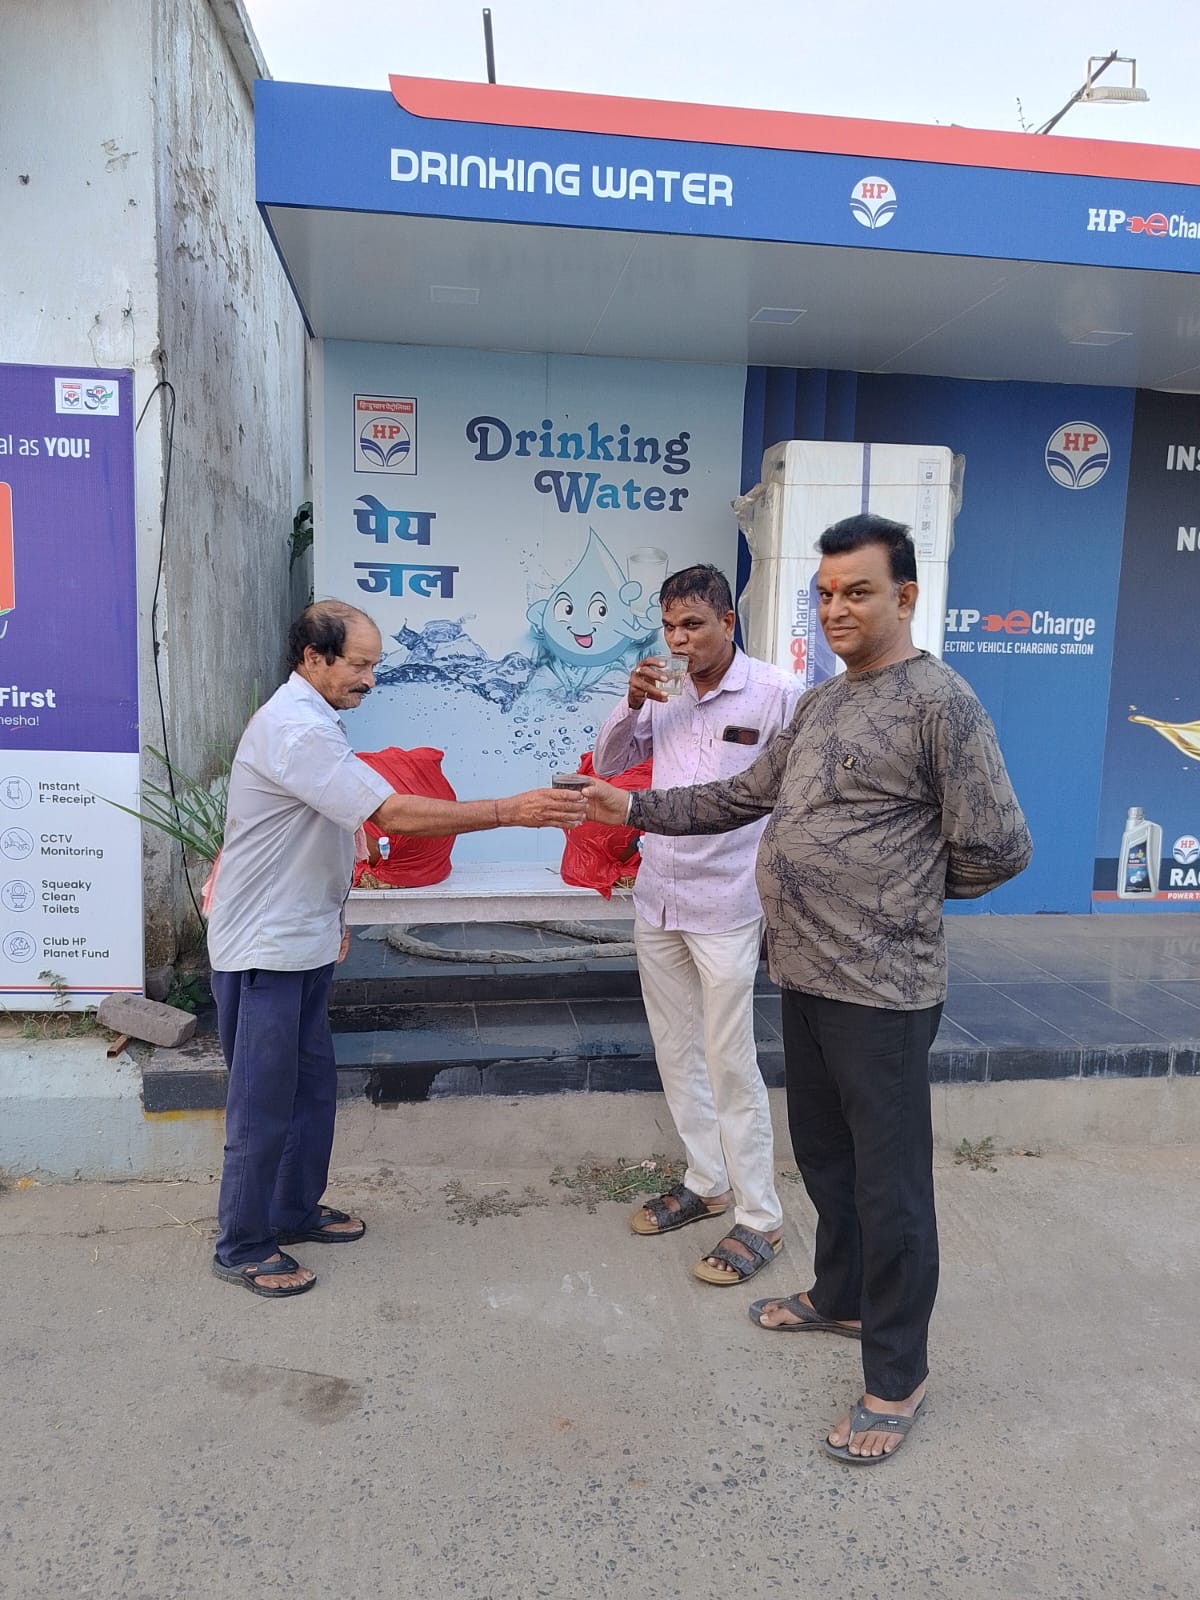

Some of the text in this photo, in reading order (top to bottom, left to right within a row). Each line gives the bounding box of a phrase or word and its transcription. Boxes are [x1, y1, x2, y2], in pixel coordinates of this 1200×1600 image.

[391, 148, 733, 207] DRINKING WATER
[861, 183, 889, 200] HP
[1087, 208, 1126, 232] HP
[372, 424, 401, 440] HP
[19, 439, 39, 456] as
[44, 437, 90, 459] YOU!
[466, 416, 691, 475] Drinking
[1063, 433, 1098, 452] HP
[534, 470, 689, 514] Water
[353, 494, 437, 546] पेय
[1177, 526, 1200, 551] N
[354, 561, 460, 599] जल
[977, 642, 1013, 654] VEHICLE
[1014, 642, 1058, 655] CHARGING
[1060, 643, 1094, 655] STATION
[0, 685, 56, 708] First
[39, 781, 80, 791] Instant
[40, 794, 96, 806] E-Receipt
[40, 833, 73, 843] CCTV
[1180, 840, 1195, 848] HP
[41, 846, 104, 859] Monitoring
[1170, 868, 1200, 886] RA
[42, 879, 92, 892] Squeaky
[42, 892, 76, 902] Clean
[1167, 892, 1194, 900] POWER
[42, 904, 80, 914] Toilets
[43, 937, 87, 946] Club HP
[43, 949, 109, 958] Planet Fund
